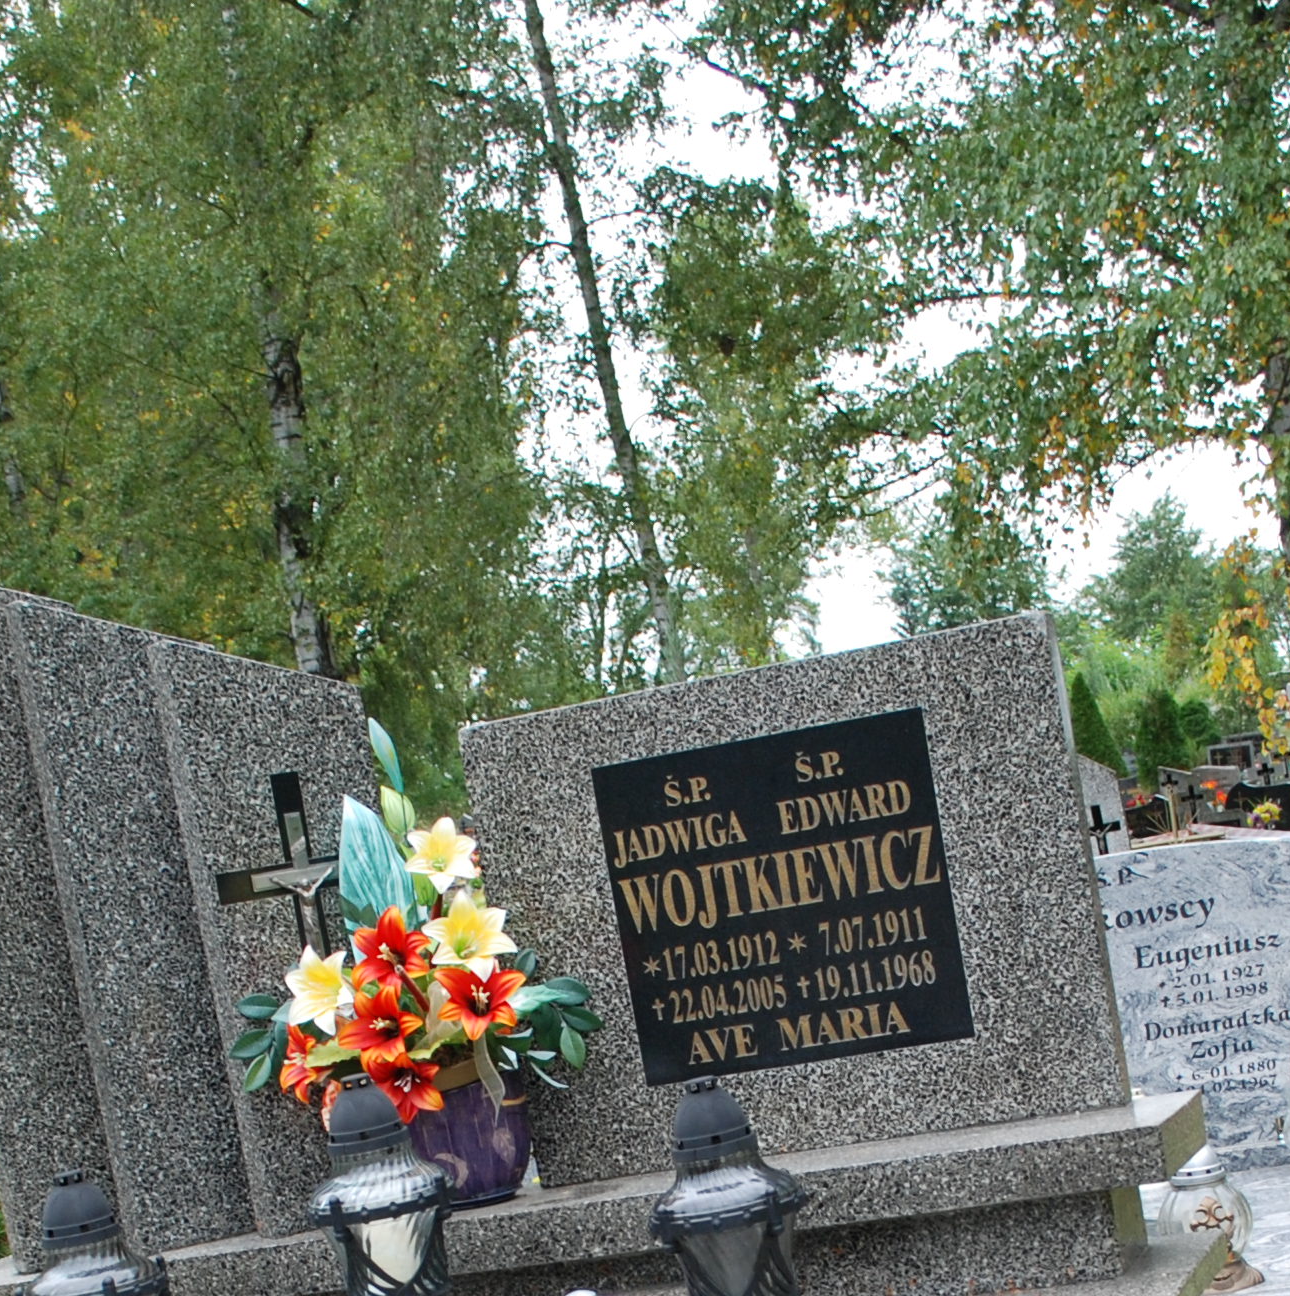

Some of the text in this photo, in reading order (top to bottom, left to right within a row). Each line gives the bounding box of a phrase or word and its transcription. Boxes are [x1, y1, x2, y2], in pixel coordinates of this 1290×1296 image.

[613, 779, 911, 869] JADWIGA EDWARD
[617, 825, 941, 934] WOJTKIEWICZ
[1135, 933, 1282, 972] Eugeniusz
[688, 1001, 910, 1066] AVE MARIA
[1191, 1037, 1254, 1063] Zofia
